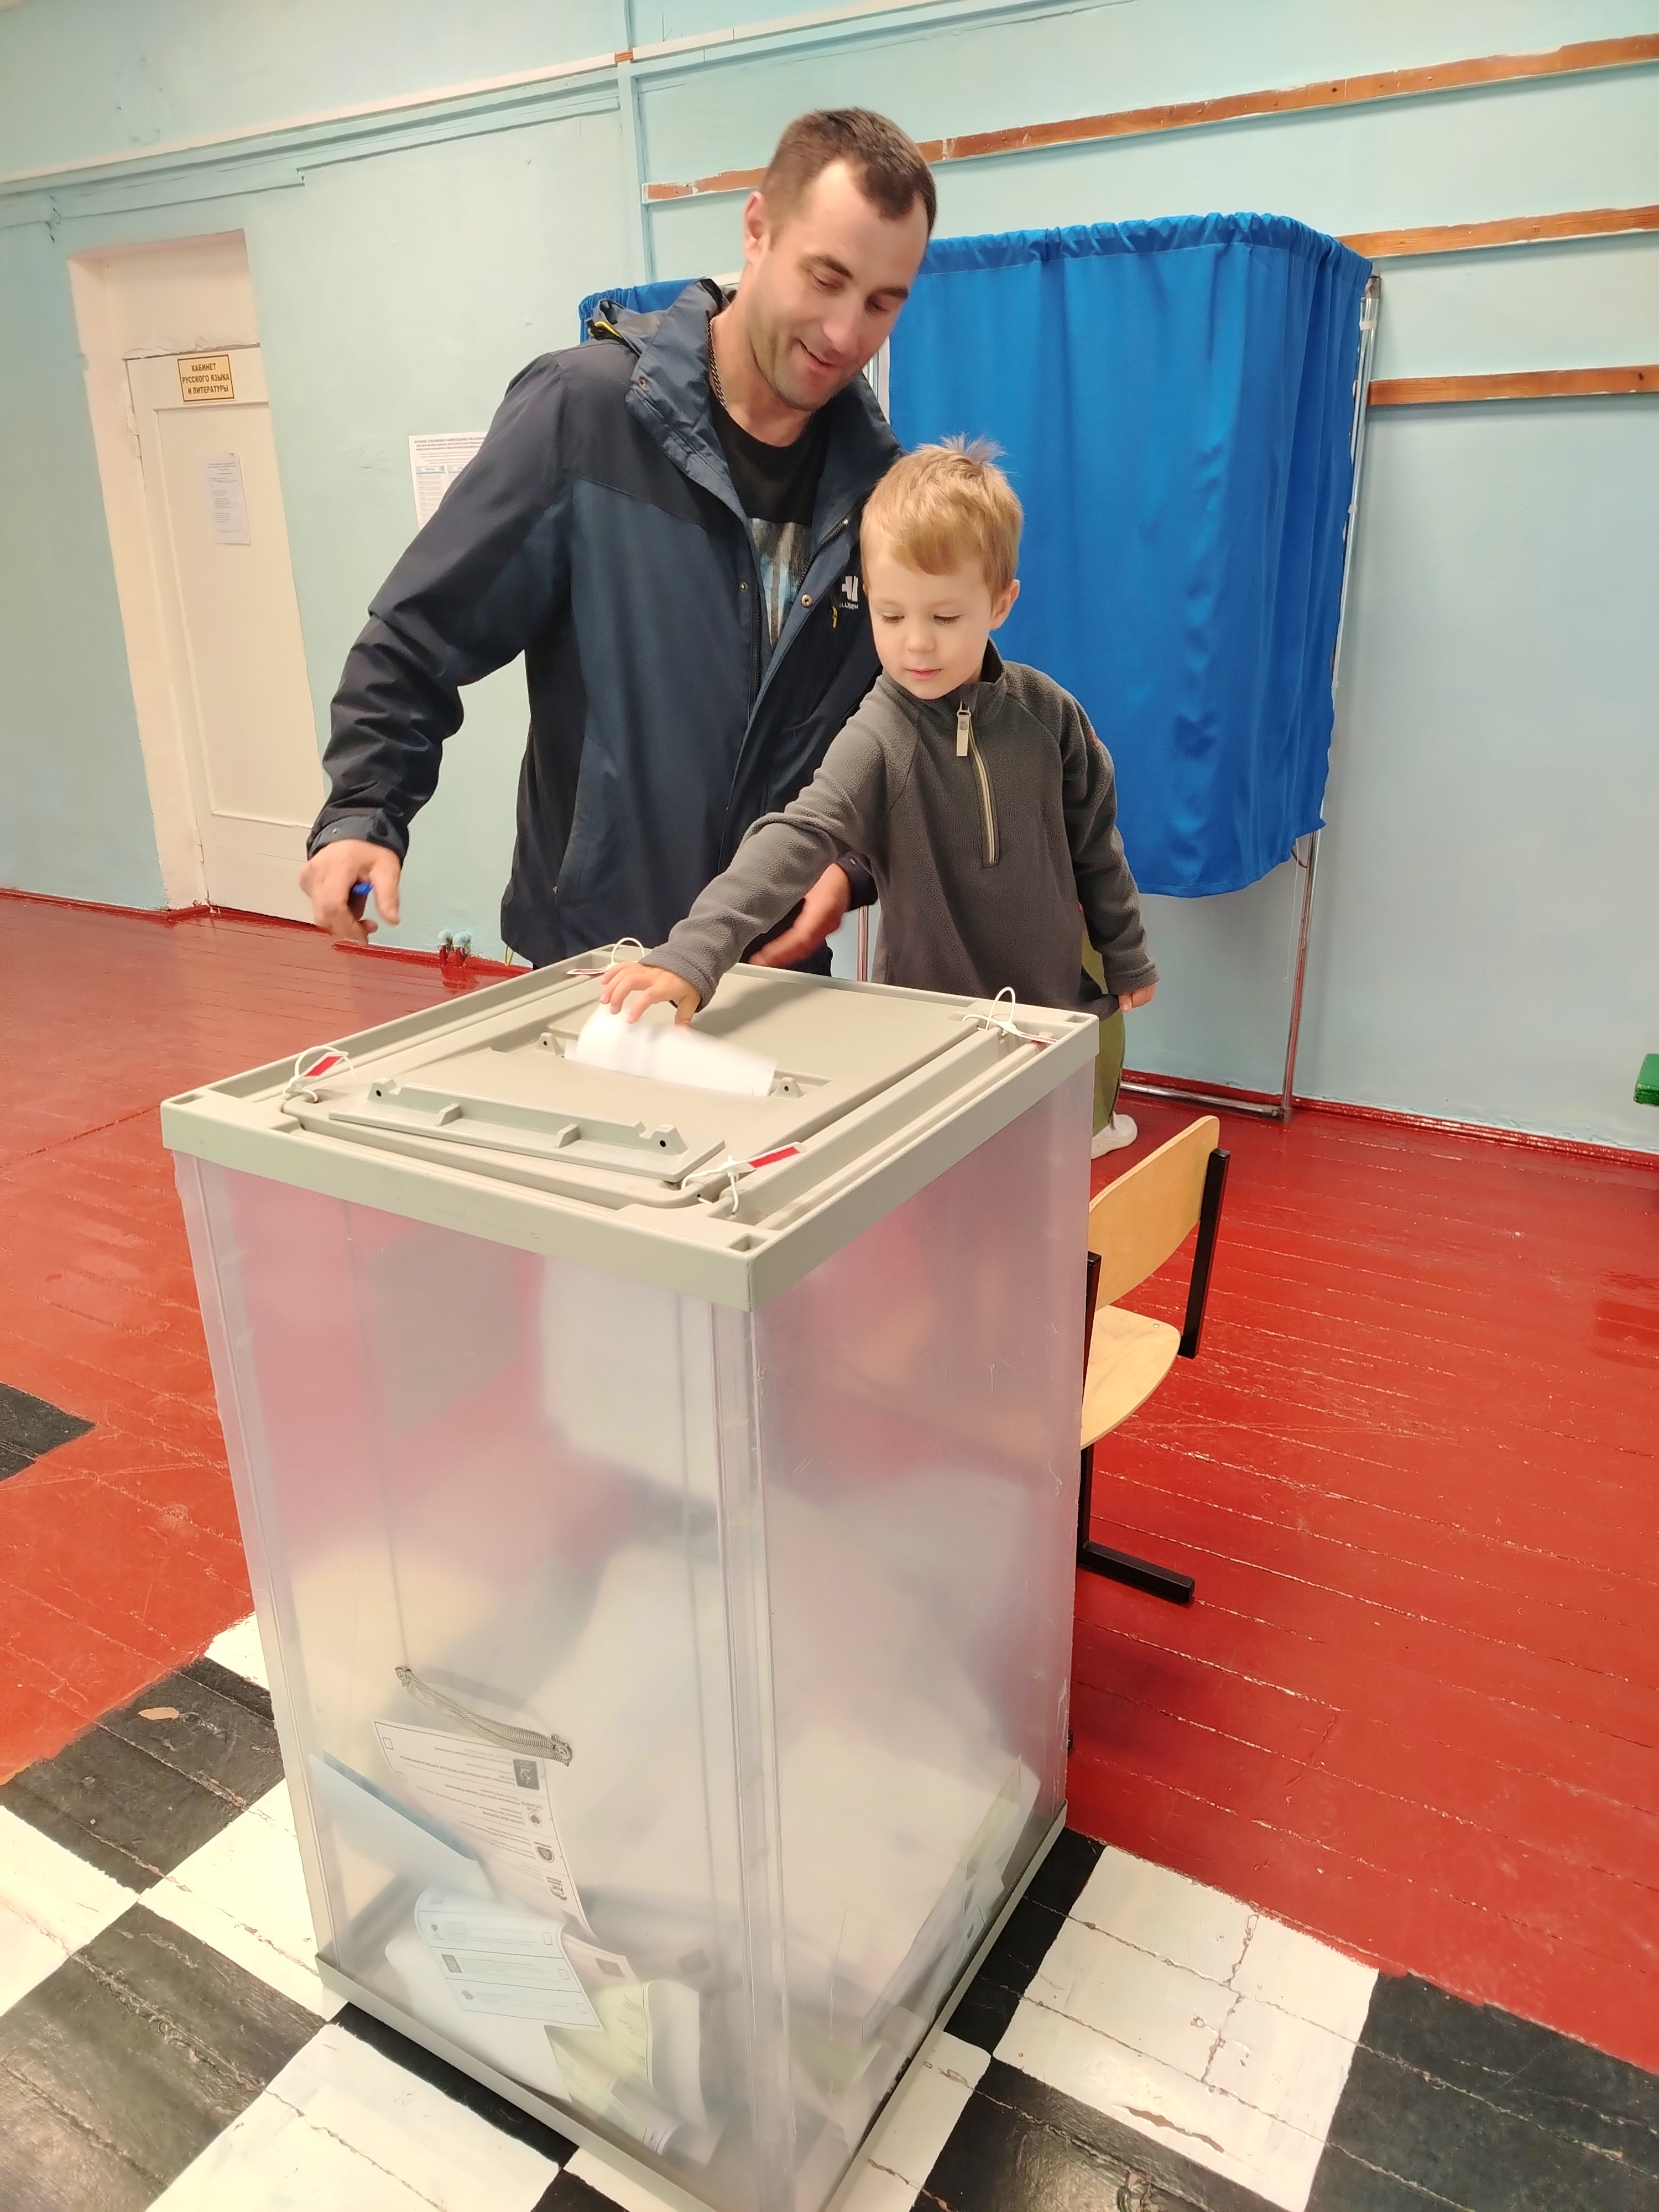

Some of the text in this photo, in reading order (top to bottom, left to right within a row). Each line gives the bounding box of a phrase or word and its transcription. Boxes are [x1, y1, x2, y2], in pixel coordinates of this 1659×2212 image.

[191, 363, 216, 372] КАБИНЕТ
[182, 373, 229, 384] РУССКОГО ЯЗЫКА
[193, 385, 229, 394] ЛИТЕРАТУРЫ
